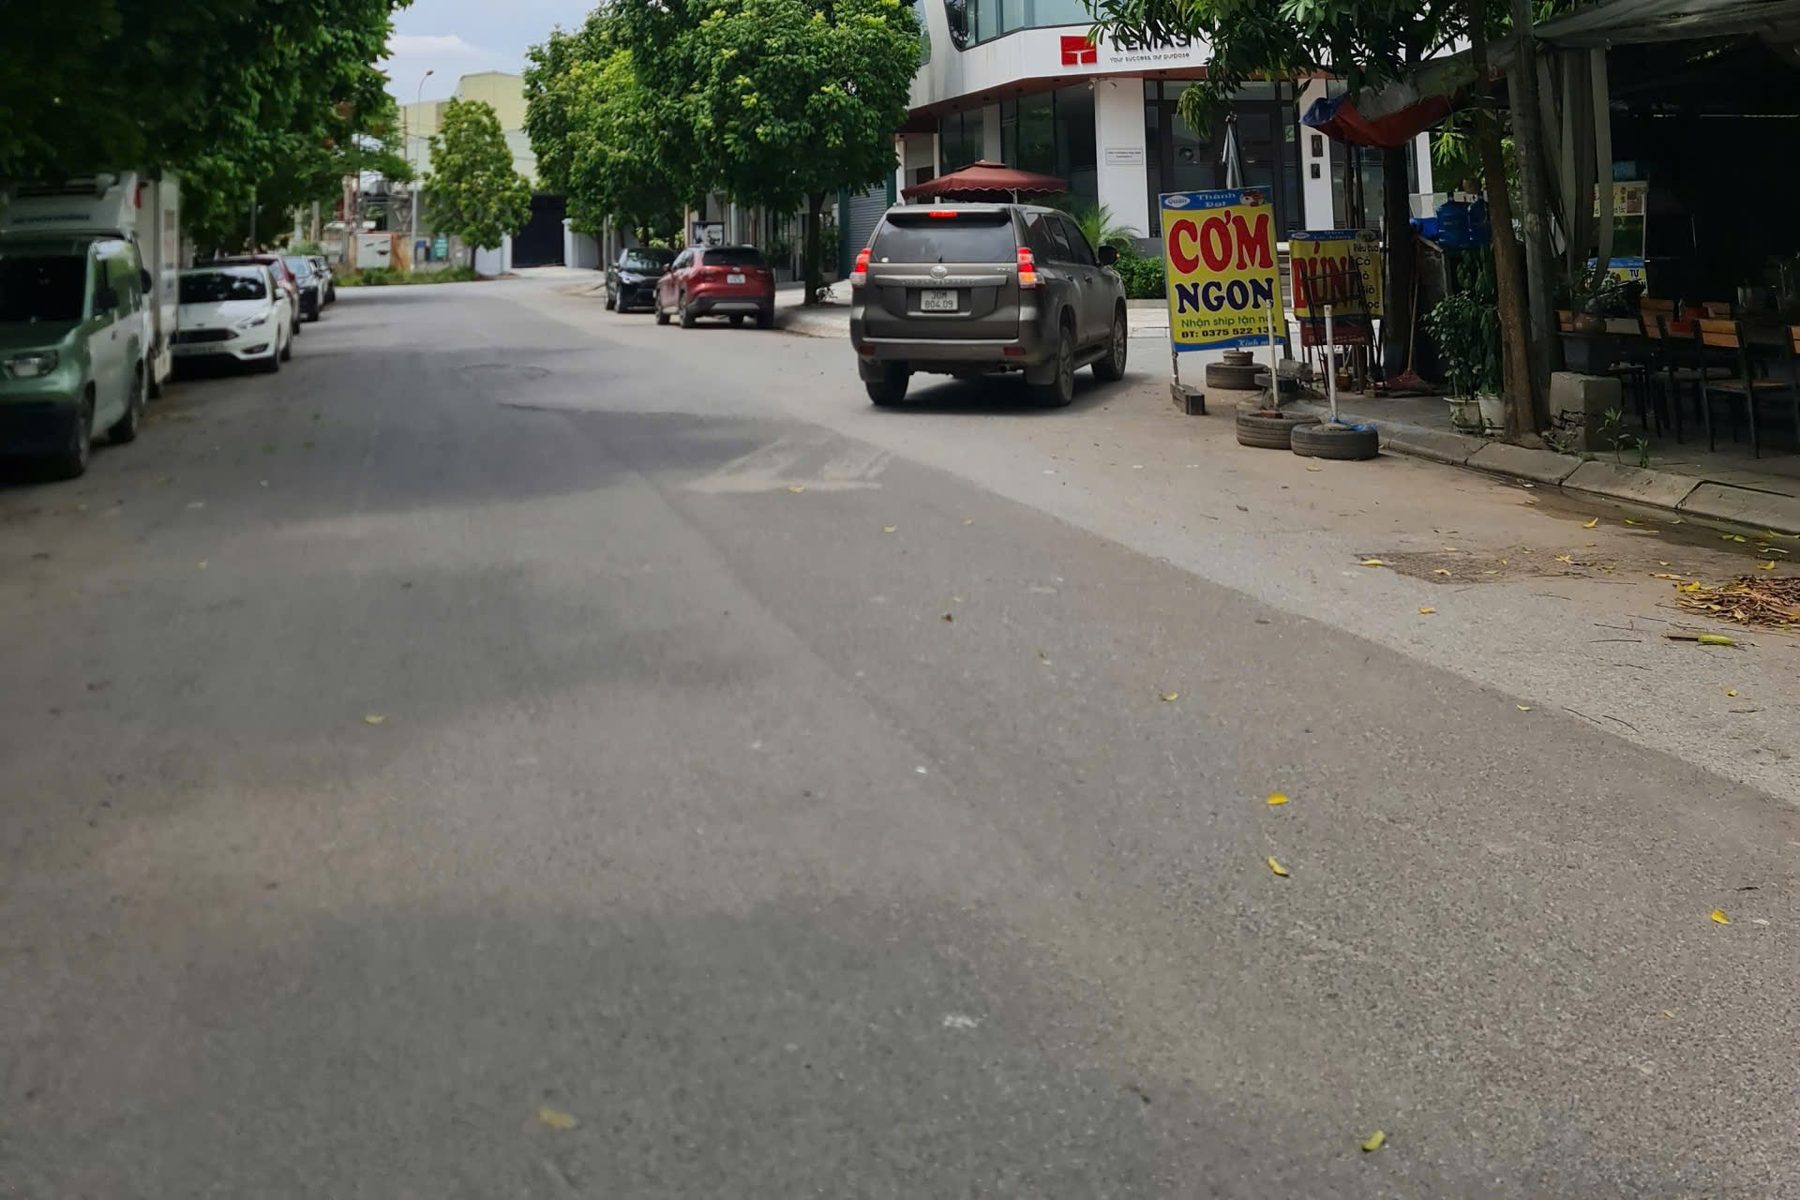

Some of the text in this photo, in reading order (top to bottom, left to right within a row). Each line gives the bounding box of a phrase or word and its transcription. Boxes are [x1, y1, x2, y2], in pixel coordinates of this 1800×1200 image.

[1168, 210, 1274, 274] CƠM
[1174, 278, 1274, 314] NGON
[1202, 328, 1229, 337] 0375
[1232, 327, 1253, 335] 522
[1213, 316, 1235, 326] ship
[1261, 314, 1275, 324] ni
